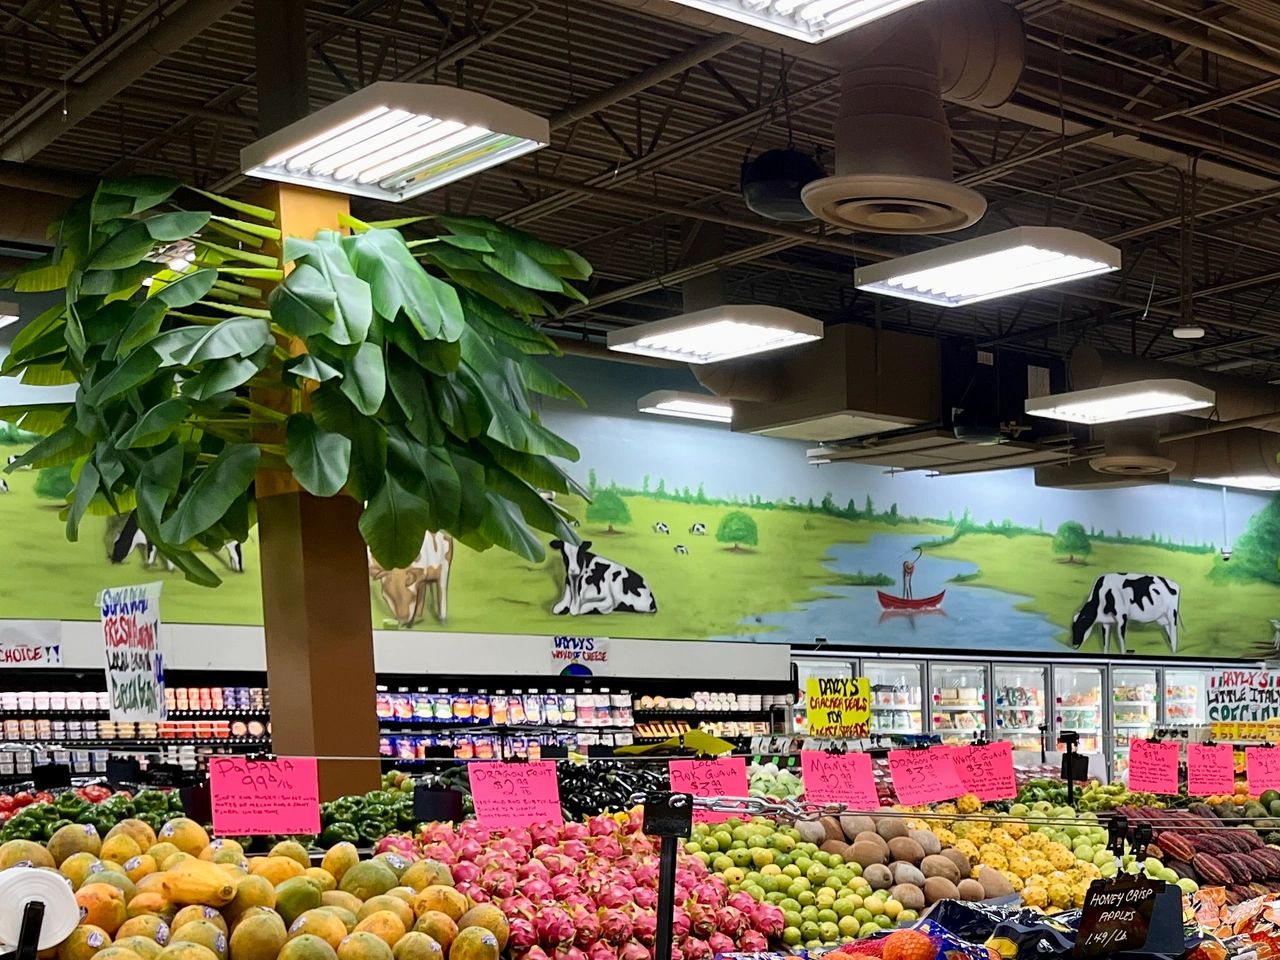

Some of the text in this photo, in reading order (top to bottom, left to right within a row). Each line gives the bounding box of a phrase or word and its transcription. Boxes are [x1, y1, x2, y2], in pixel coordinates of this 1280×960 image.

[827, 710, 842, 724] FOR
[811, 759, 855, 773] MAMEY
[473, 769, 523, 781] DRAGON
[1090, 893, 1124, 907] HONEY
[1098, 910, 1136, 922] APPLES
